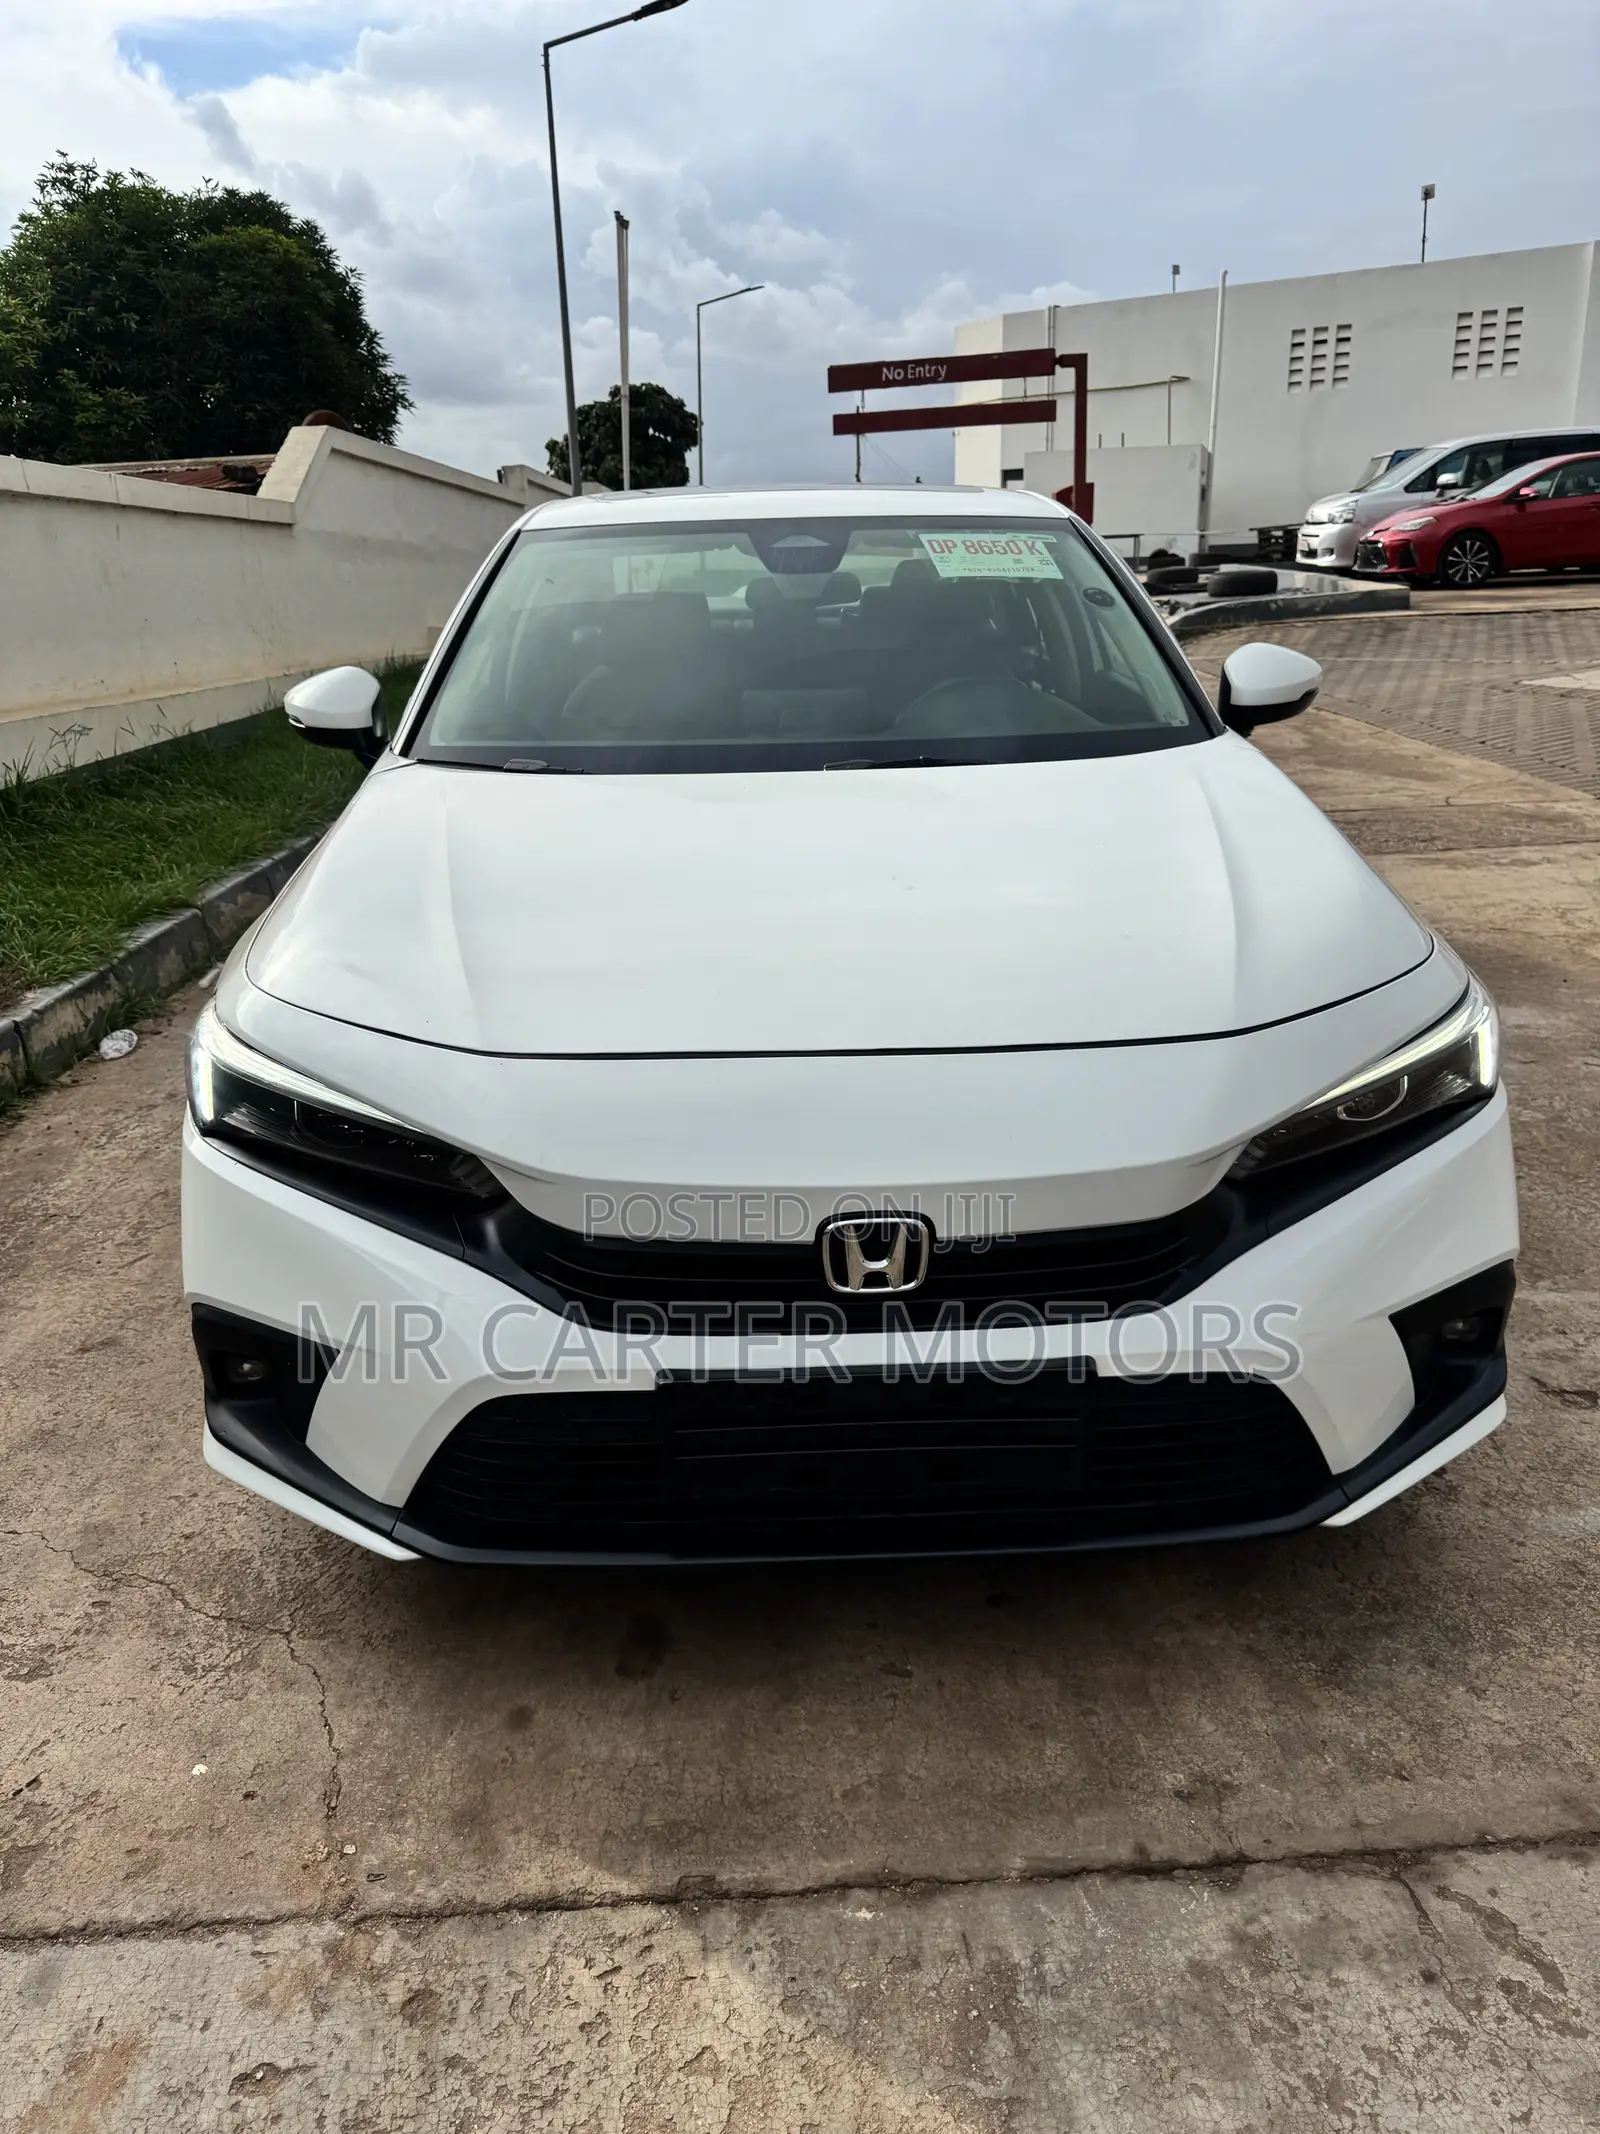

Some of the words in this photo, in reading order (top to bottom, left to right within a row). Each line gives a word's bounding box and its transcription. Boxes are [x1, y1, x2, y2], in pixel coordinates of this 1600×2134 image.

[881, 365, 905, 382] No
[907, 363, 947, 381] Entry
[926, 539, 958, 554] DP
